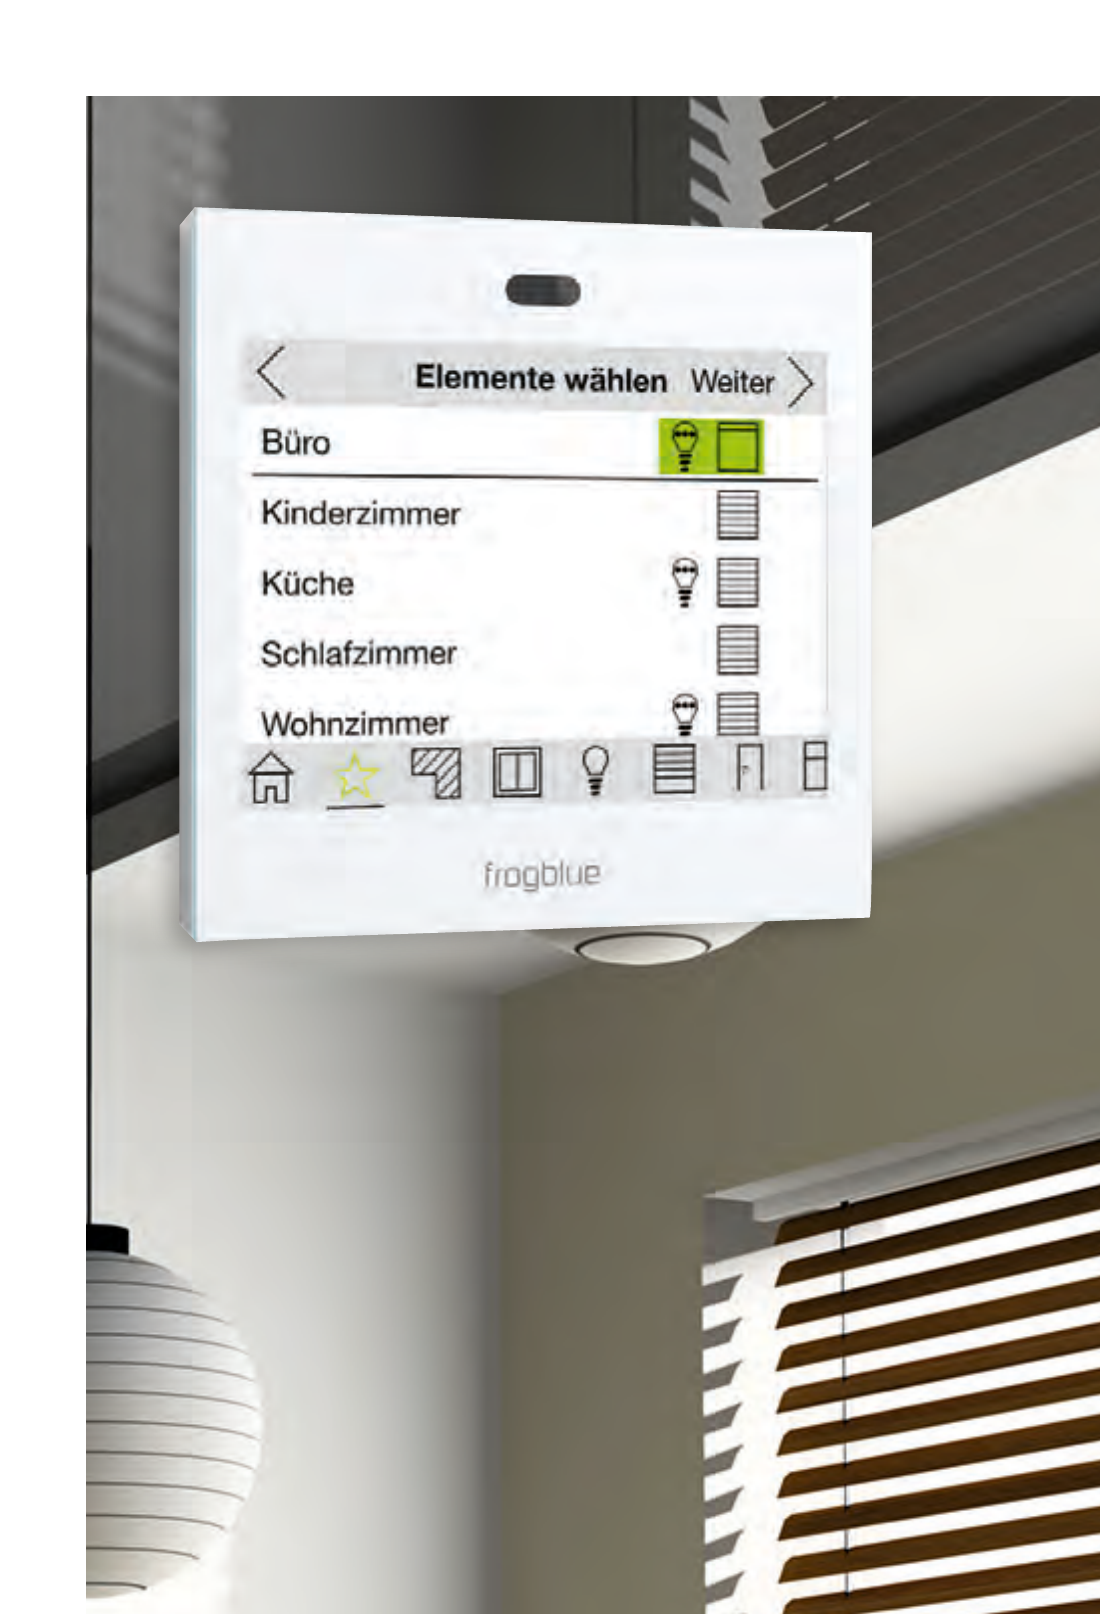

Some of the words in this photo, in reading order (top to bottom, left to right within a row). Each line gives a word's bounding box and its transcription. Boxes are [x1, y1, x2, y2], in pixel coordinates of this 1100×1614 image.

[415, 363, 556, 392] Elemente
[564, 365, 668, 394] wählen
[690, 367, 776, 395] Weiter
[261, 427, 331, 456] Büro
[261, 498, 461, 527] Kinderzimmer
[261, 569, 355, 597] Küche
[260, 638, 458, 668] Schlafzimmer
[260, 710, 450, 738] Wohnzimmer
[483, 860, 601, 893] frogblue
